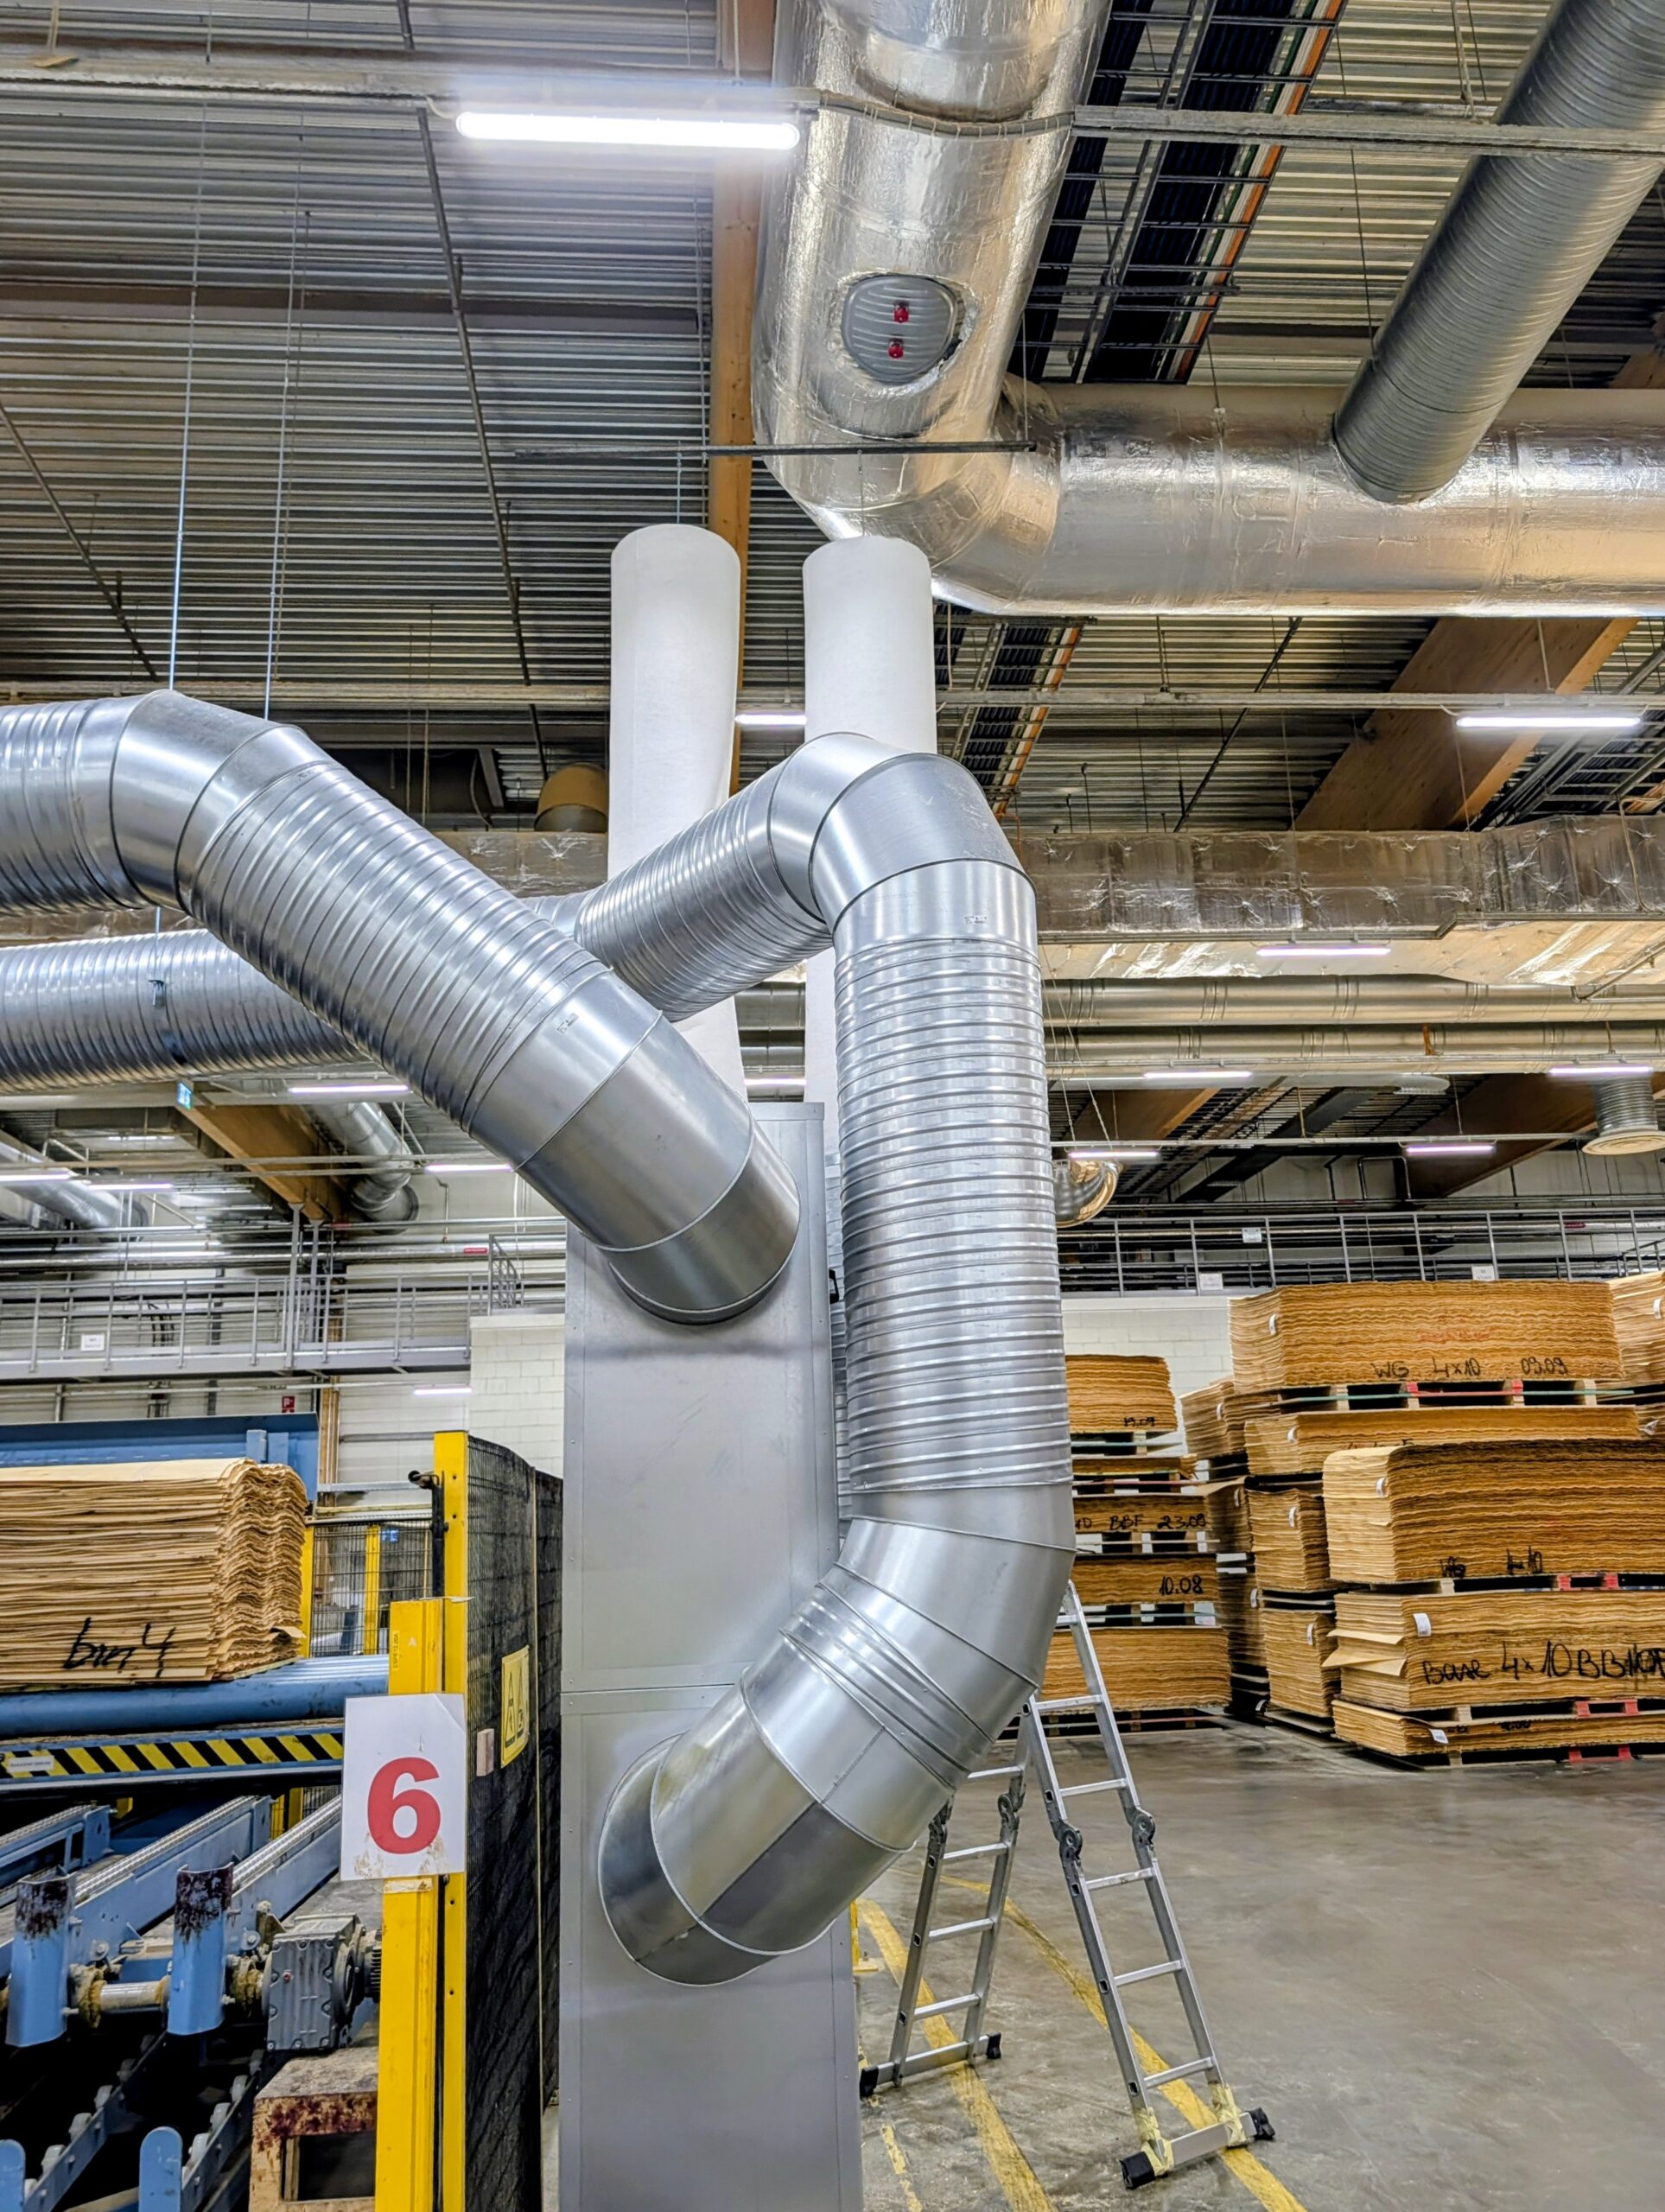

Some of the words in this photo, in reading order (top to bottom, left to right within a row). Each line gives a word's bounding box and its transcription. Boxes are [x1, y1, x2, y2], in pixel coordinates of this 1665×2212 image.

[1370, 1360, 1410, 1378] WG
[1432, 1357, 1481, 1377] 4x10
[1159, 1574, 1204, 1596] 10.08
[141, 1621, 178, 1679] 4
[367, 1757, 441, 1854] 6
